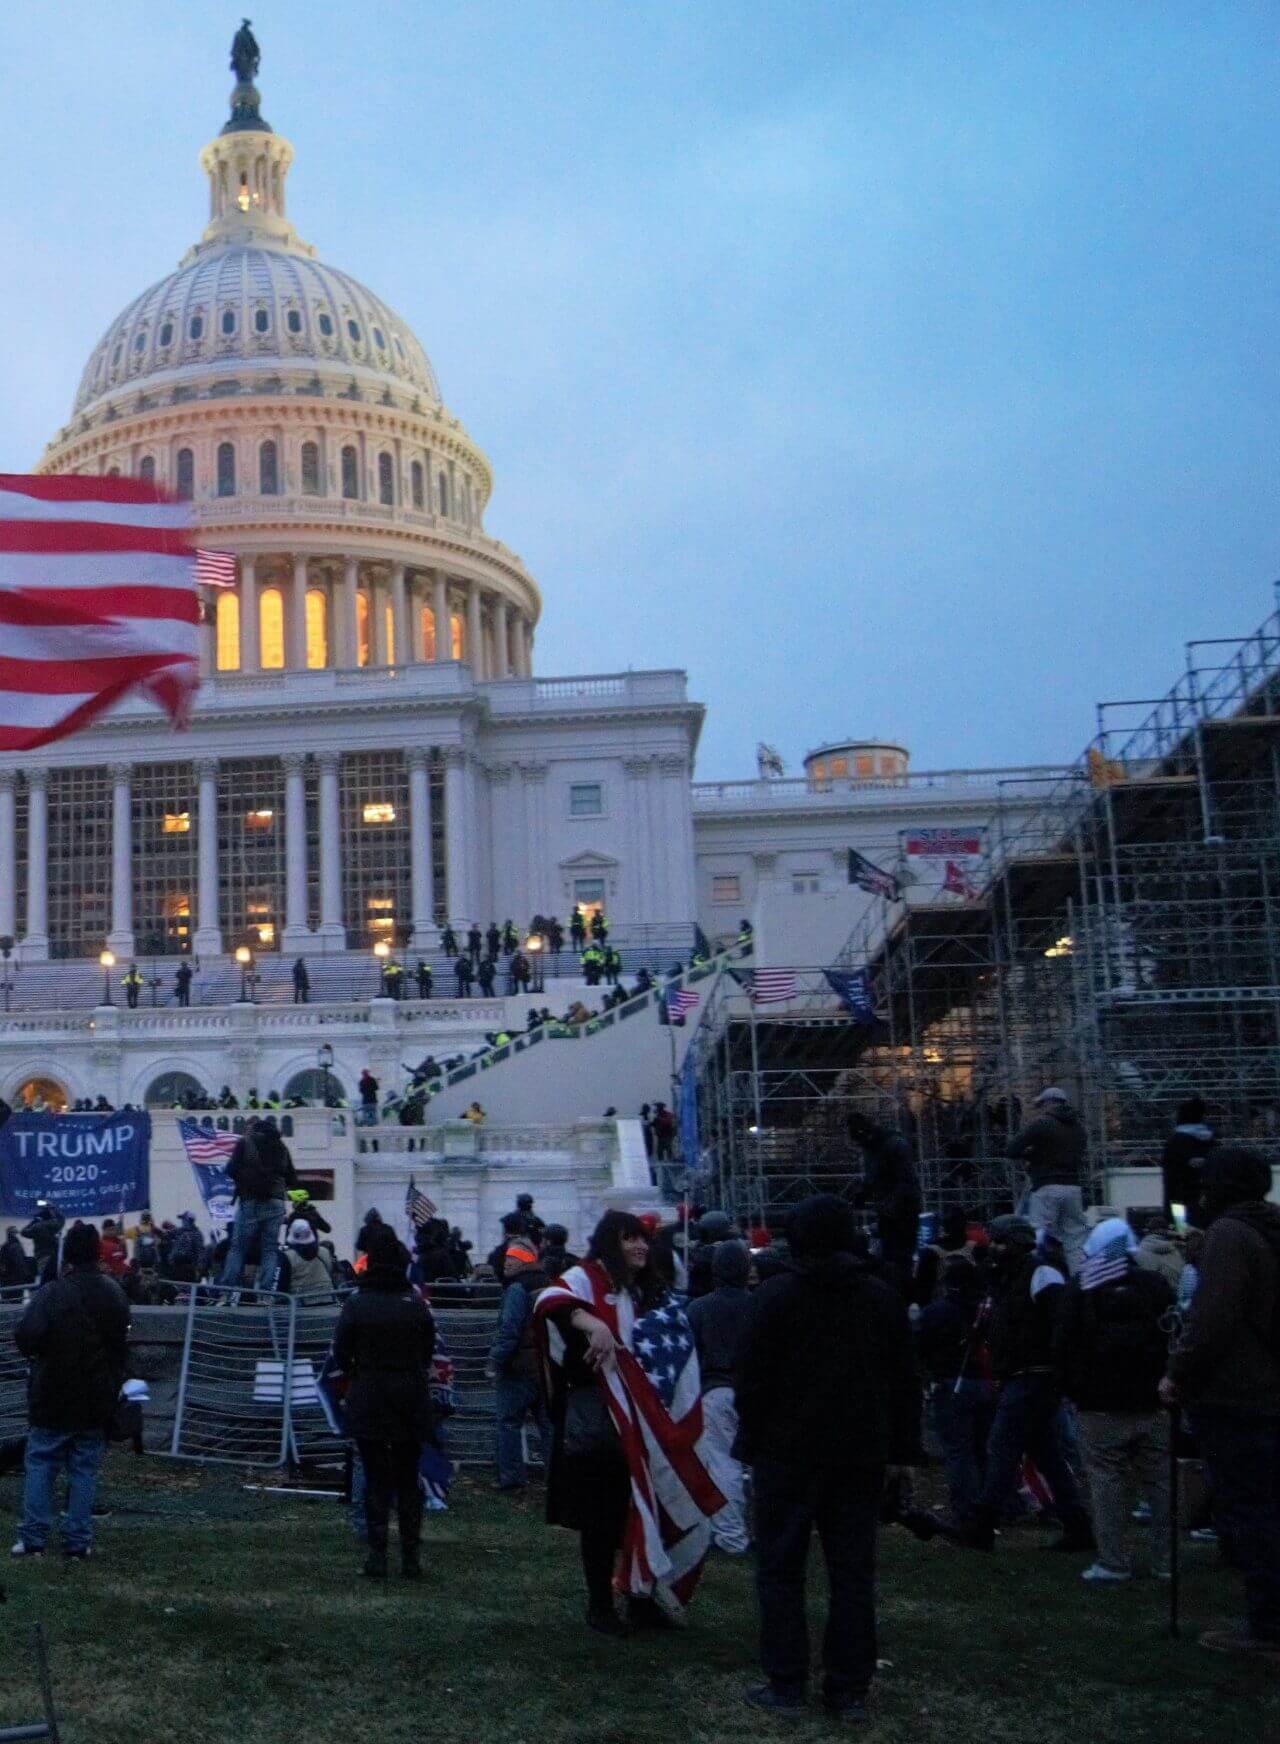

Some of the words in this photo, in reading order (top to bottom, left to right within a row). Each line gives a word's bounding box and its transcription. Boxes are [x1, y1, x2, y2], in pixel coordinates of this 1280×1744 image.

[13, 1125, 134, 1157] TRUMP
[46, 1187, 96, 1199] AMERICA
[99, 1182, 137, 1194] GREAT
